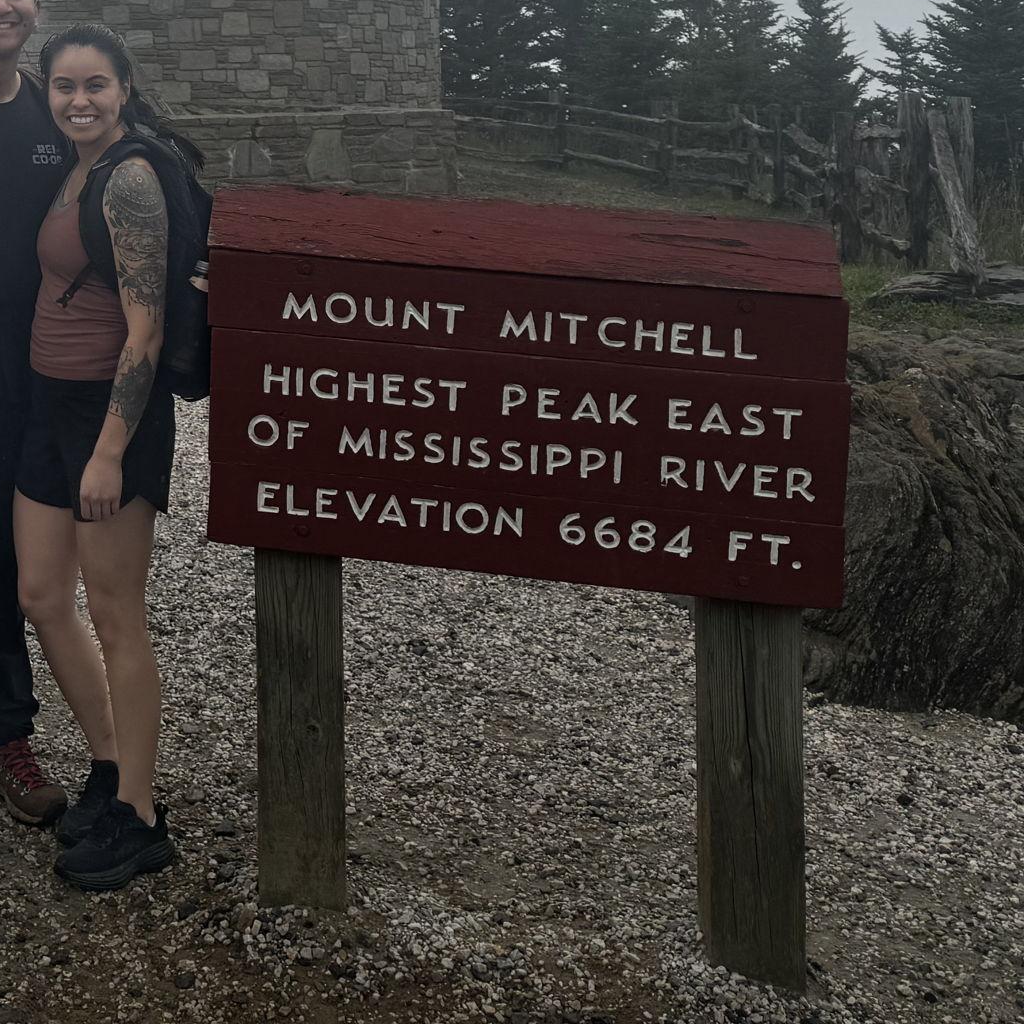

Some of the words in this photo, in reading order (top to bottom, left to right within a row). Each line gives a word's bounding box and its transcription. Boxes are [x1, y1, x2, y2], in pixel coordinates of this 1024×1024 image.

[36, 144, 56, 154] REI
[282, 292, 465, 335] MOUNT
[499, 309, 758, 361] MITCHELL
[263, 363, 467, 412] HIGHEST
[501, 383, 639, 426] PEAK
[668, 398, 803, 440] EAST
[247, 414, 310, 450] OF
[338, 425, 623, 484] MISSISSIPPI
[660, 455, 816, 503] RIVER
[257, 481, 523, 538] ELEVATION
[559, 512, 693, 558] 6684
[727, 530, 802, 570] FT.
